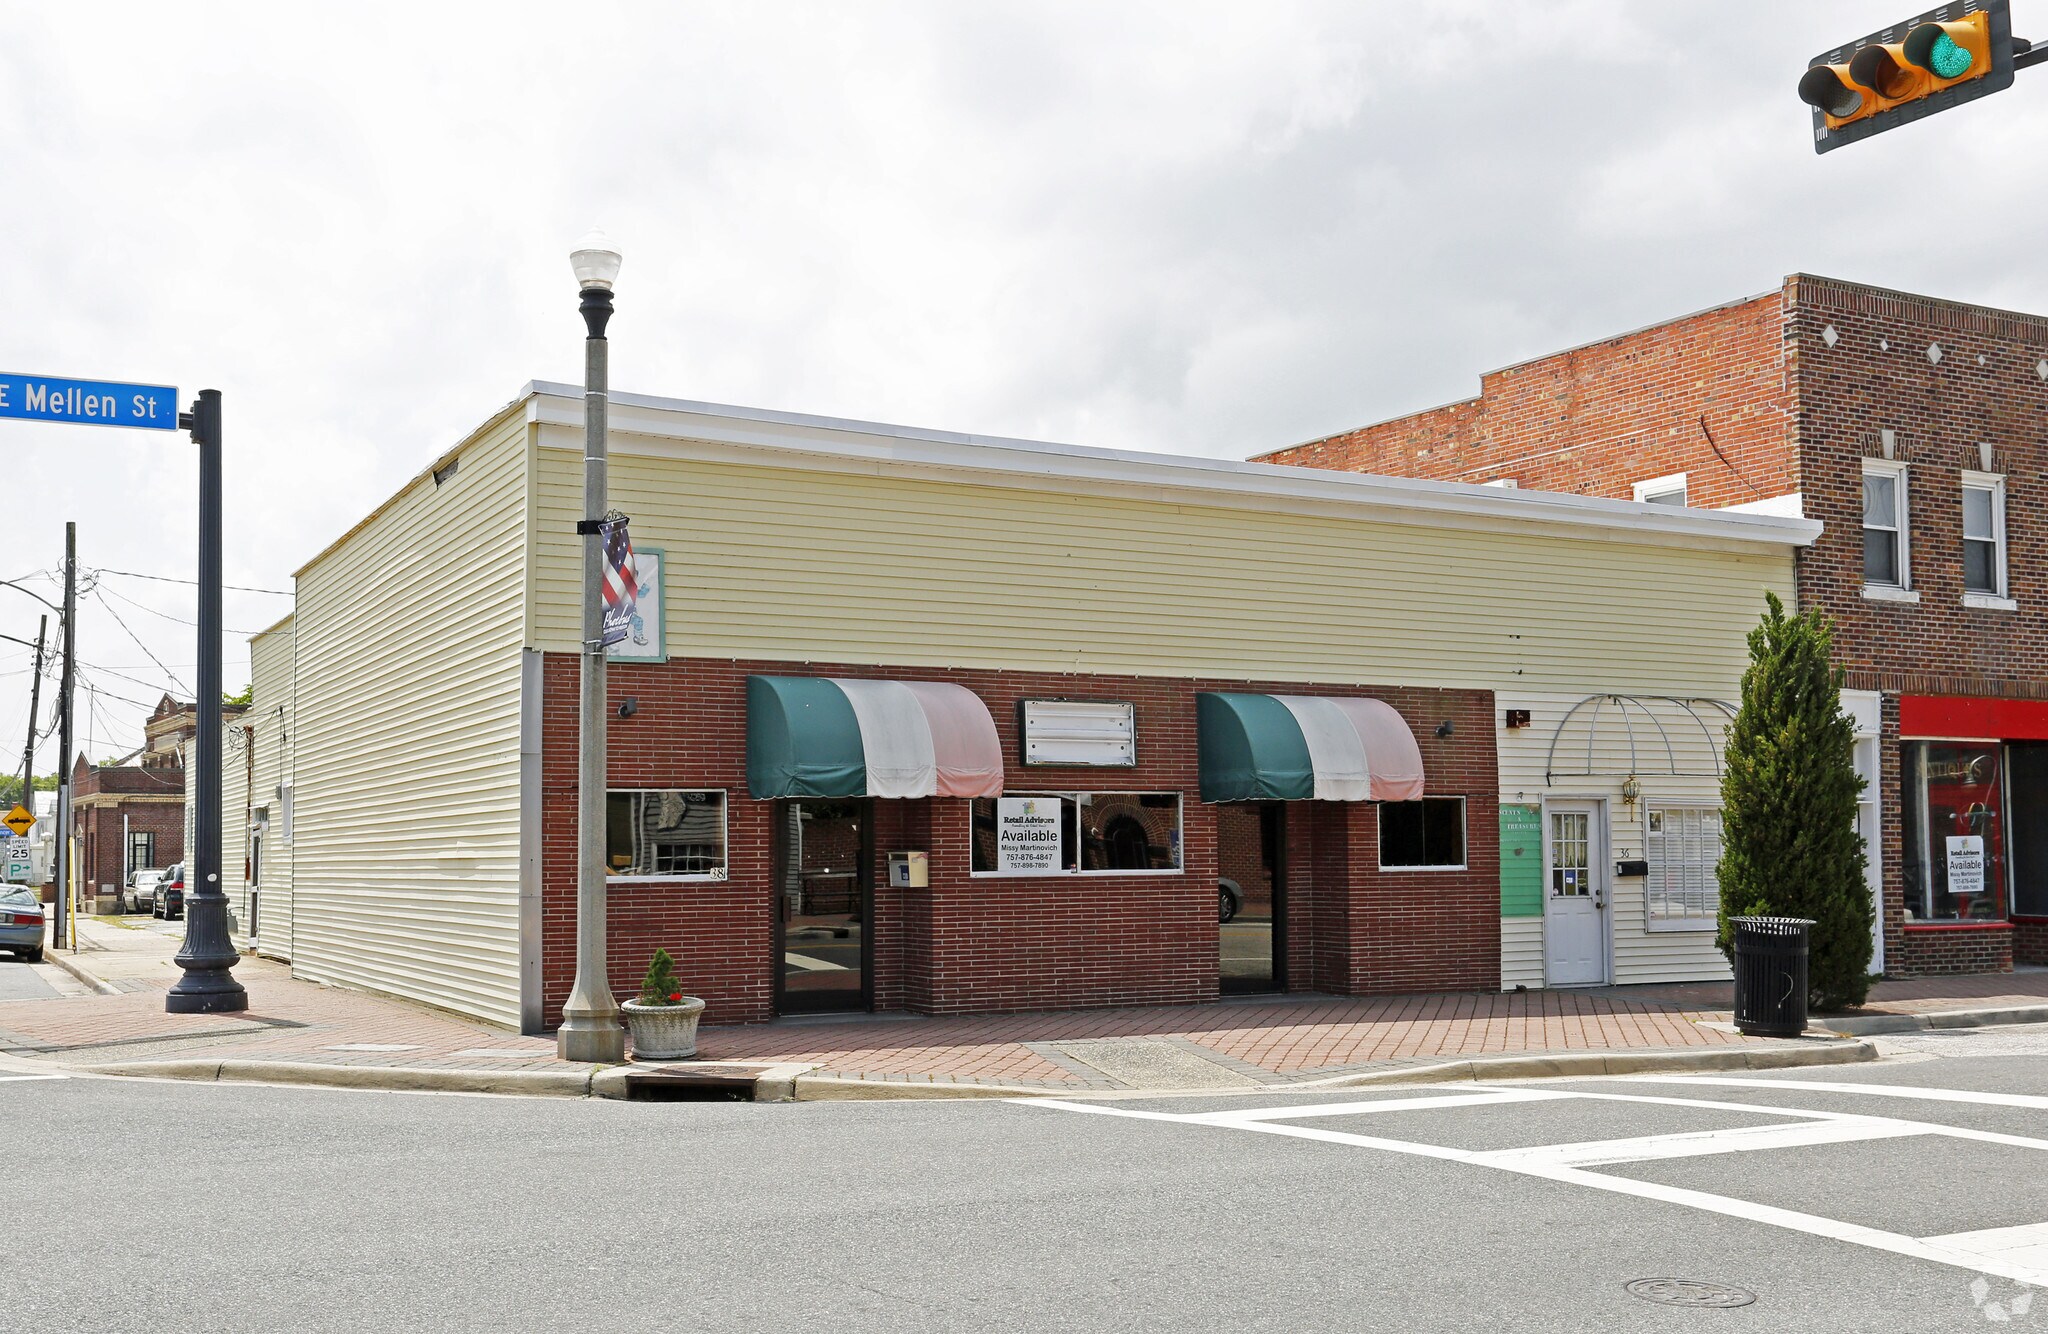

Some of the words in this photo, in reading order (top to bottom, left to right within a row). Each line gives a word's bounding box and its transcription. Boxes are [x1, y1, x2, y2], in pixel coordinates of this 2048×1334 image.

[0, 384, 10, 407] E
[25, 383, 116, 418] Mellen
[131, 394, 157, 418] St
[1001, 829, 1058, 842] Available
[12, 849, 28, 858] 25
[1620, 847, 1630, 859] 36
[10, 864, 21, 876] P
[1950, 860, 1982, 870] Available
[710, 867, 725, 879] 38
